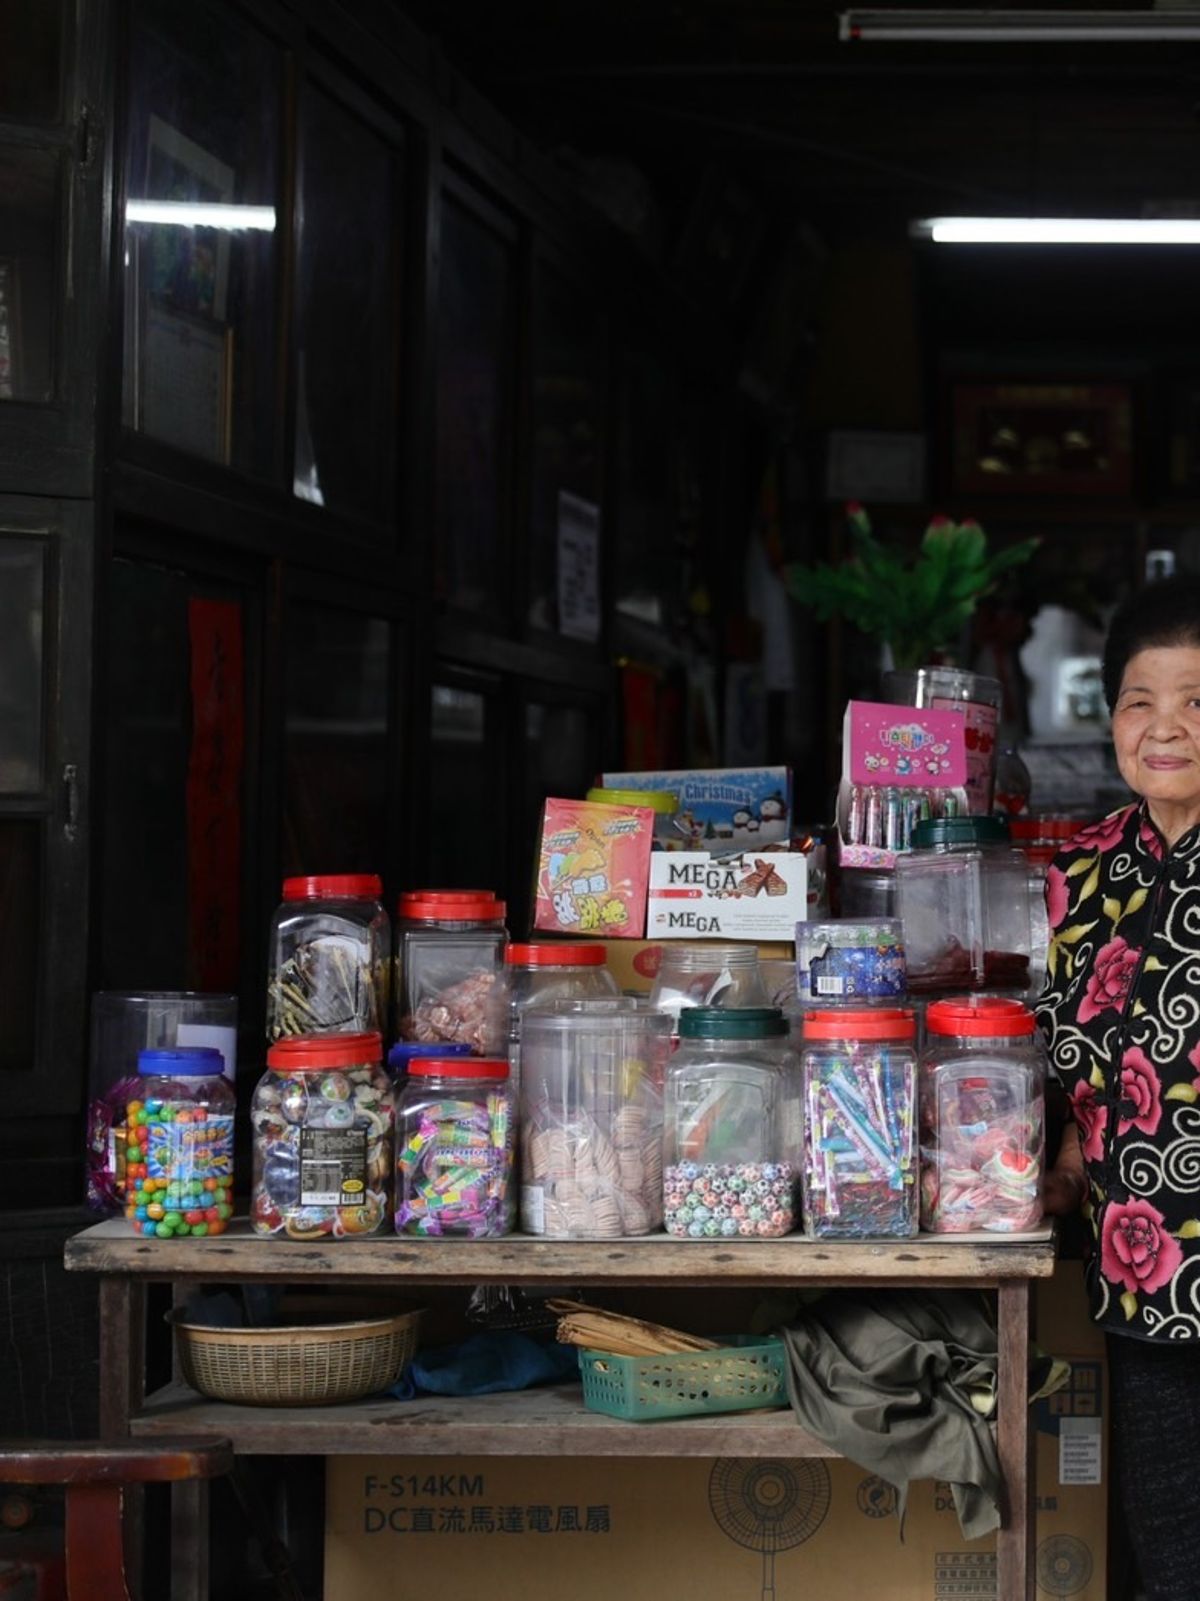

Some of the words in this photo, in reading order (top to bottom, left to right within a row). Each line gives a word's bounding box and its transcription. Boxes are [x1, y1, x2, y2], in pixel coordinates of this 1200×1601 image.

[685, 783, 753, 806] Christmas
[669, 863, 738, 890] MEGA
[669, 911, 721, 932] MEGA
[365, 1475, 484, 1498] F-S14KM
[364, 1504, 611, 1533] DC直流馬達電風扇
